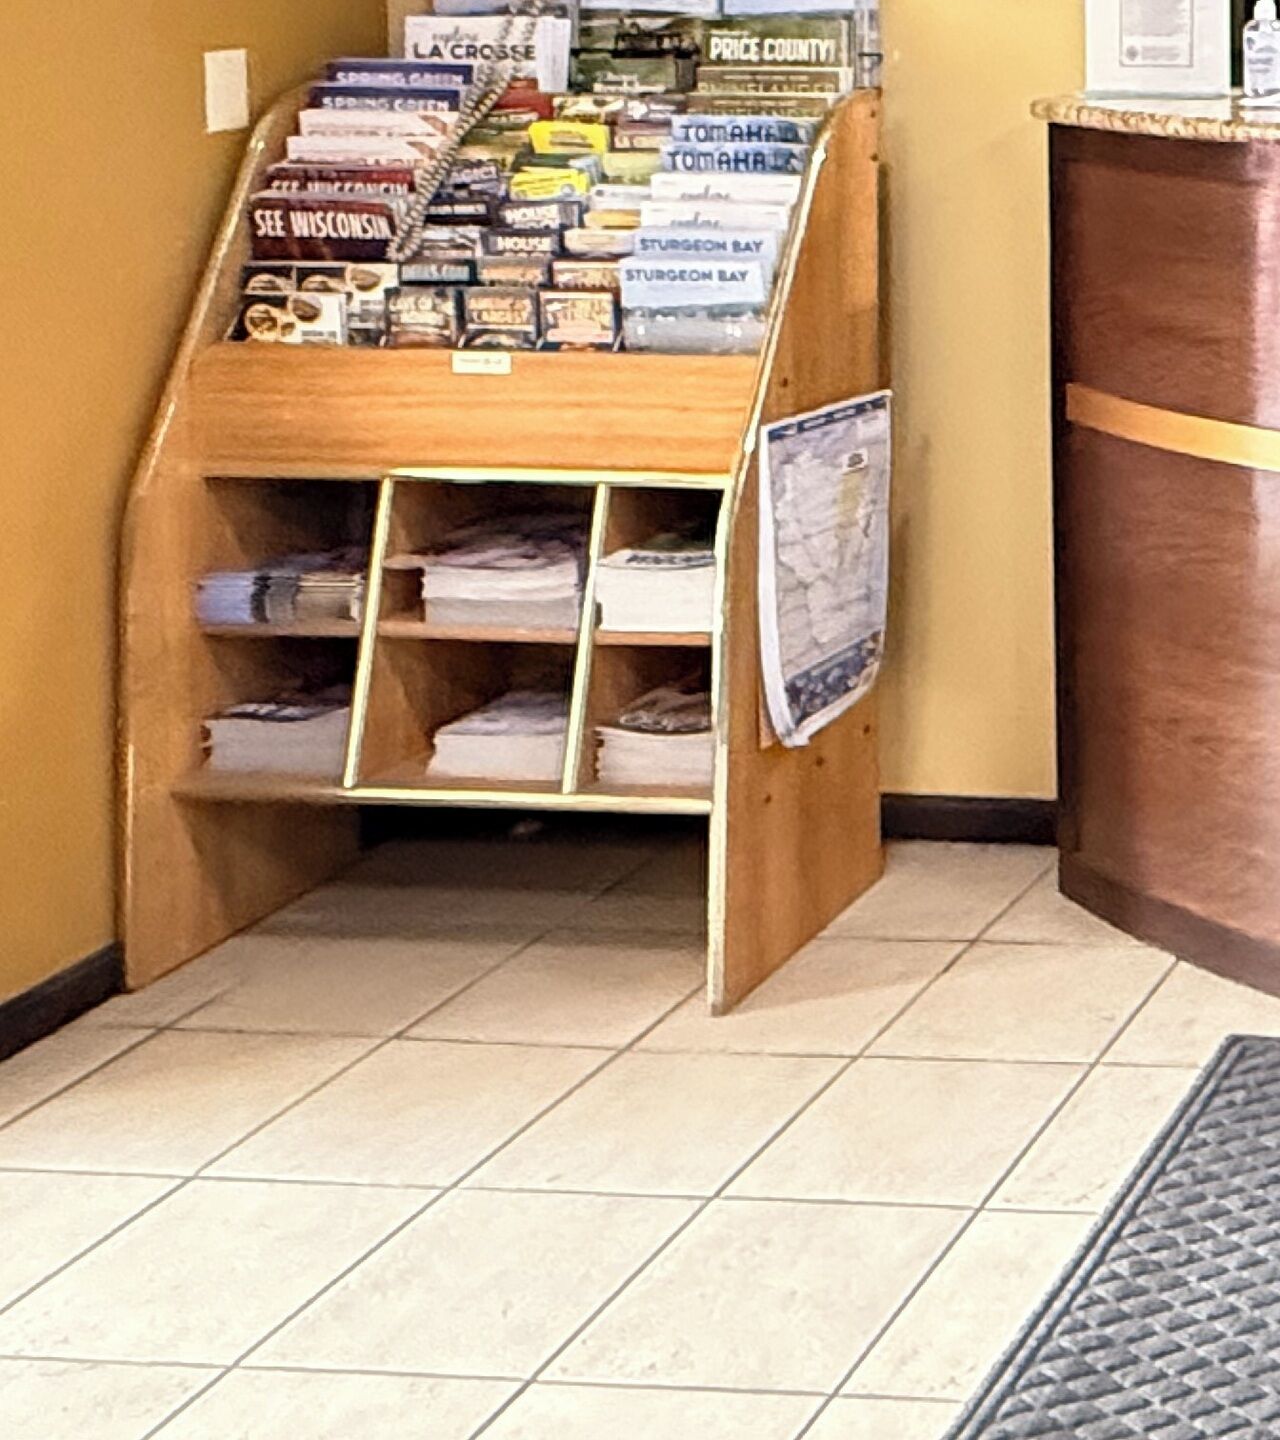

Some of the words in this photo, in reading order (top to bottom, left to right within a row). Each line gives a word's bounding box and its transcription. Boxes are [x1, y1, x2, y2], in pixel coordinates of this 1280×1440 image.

[413, 43, 443, 59] LA
[450, 44, 536, 59] CROSSE
[709, 37, 760, 61] PRICE
[336, 72, 405, 84] SPRING
[322, 97, 390, 110] SPRING
[254, 209, 286, 237] SEE
[289, 211, 393, 238] WISCONSIN
[497, 236, 551, 252] HOUSE
[640, 239, 728, 252] STURGEON
[731, 240, 763, 253] BAY
[626, 269, 714, 282] STURGEON
[718, 269, 749, 282] BAY
